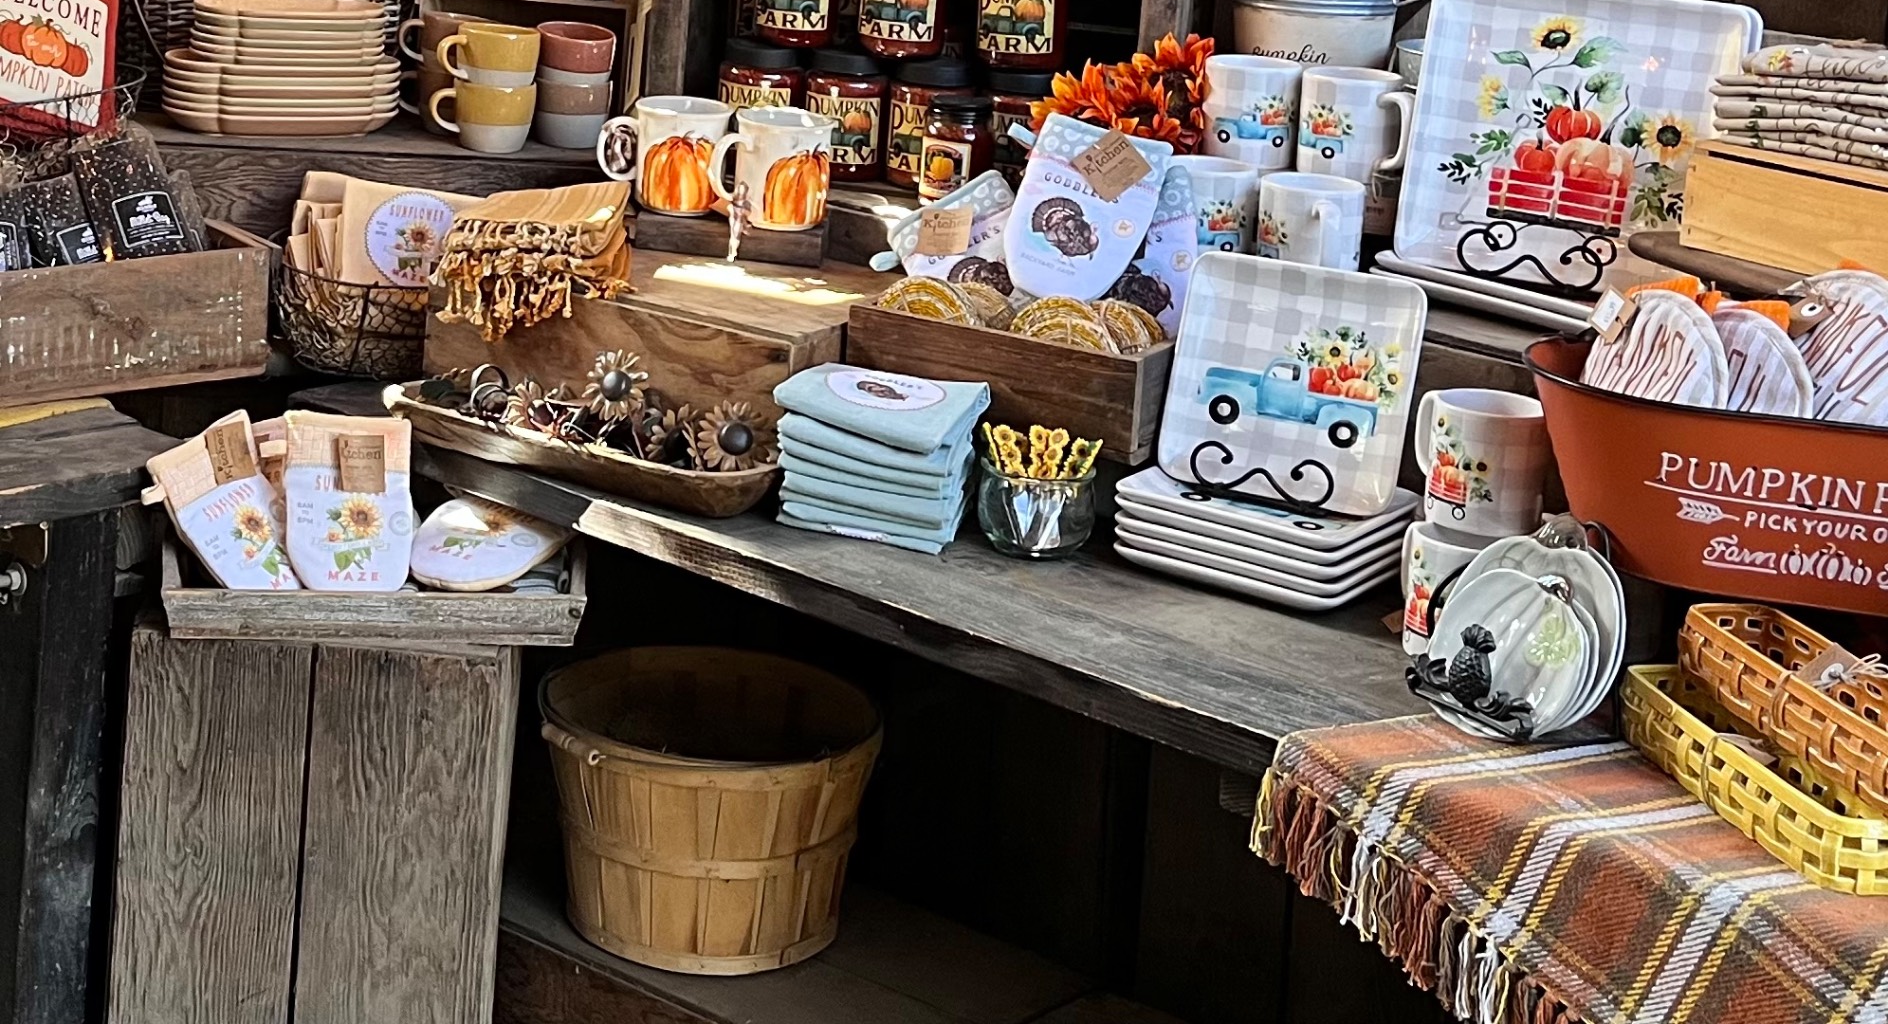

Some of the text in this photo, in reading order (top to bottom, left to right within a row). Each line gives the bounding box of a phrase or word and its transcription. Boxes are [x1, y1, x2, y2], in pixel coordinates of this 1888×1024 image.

[757, 9, 827, 29] ARM
[0, 55, 50, 94] MPKIN
[389, 204, 445, 222] SUNFLOWER
[1655, 451, 1866, 510] PUMPKIN
[1744, 510, 1797, 533] PICK
[1802, 518, 1868, 543] YOUR
[1702, 534, 1777, 568] Farm
[327, 570, 380, 582] MAZE
